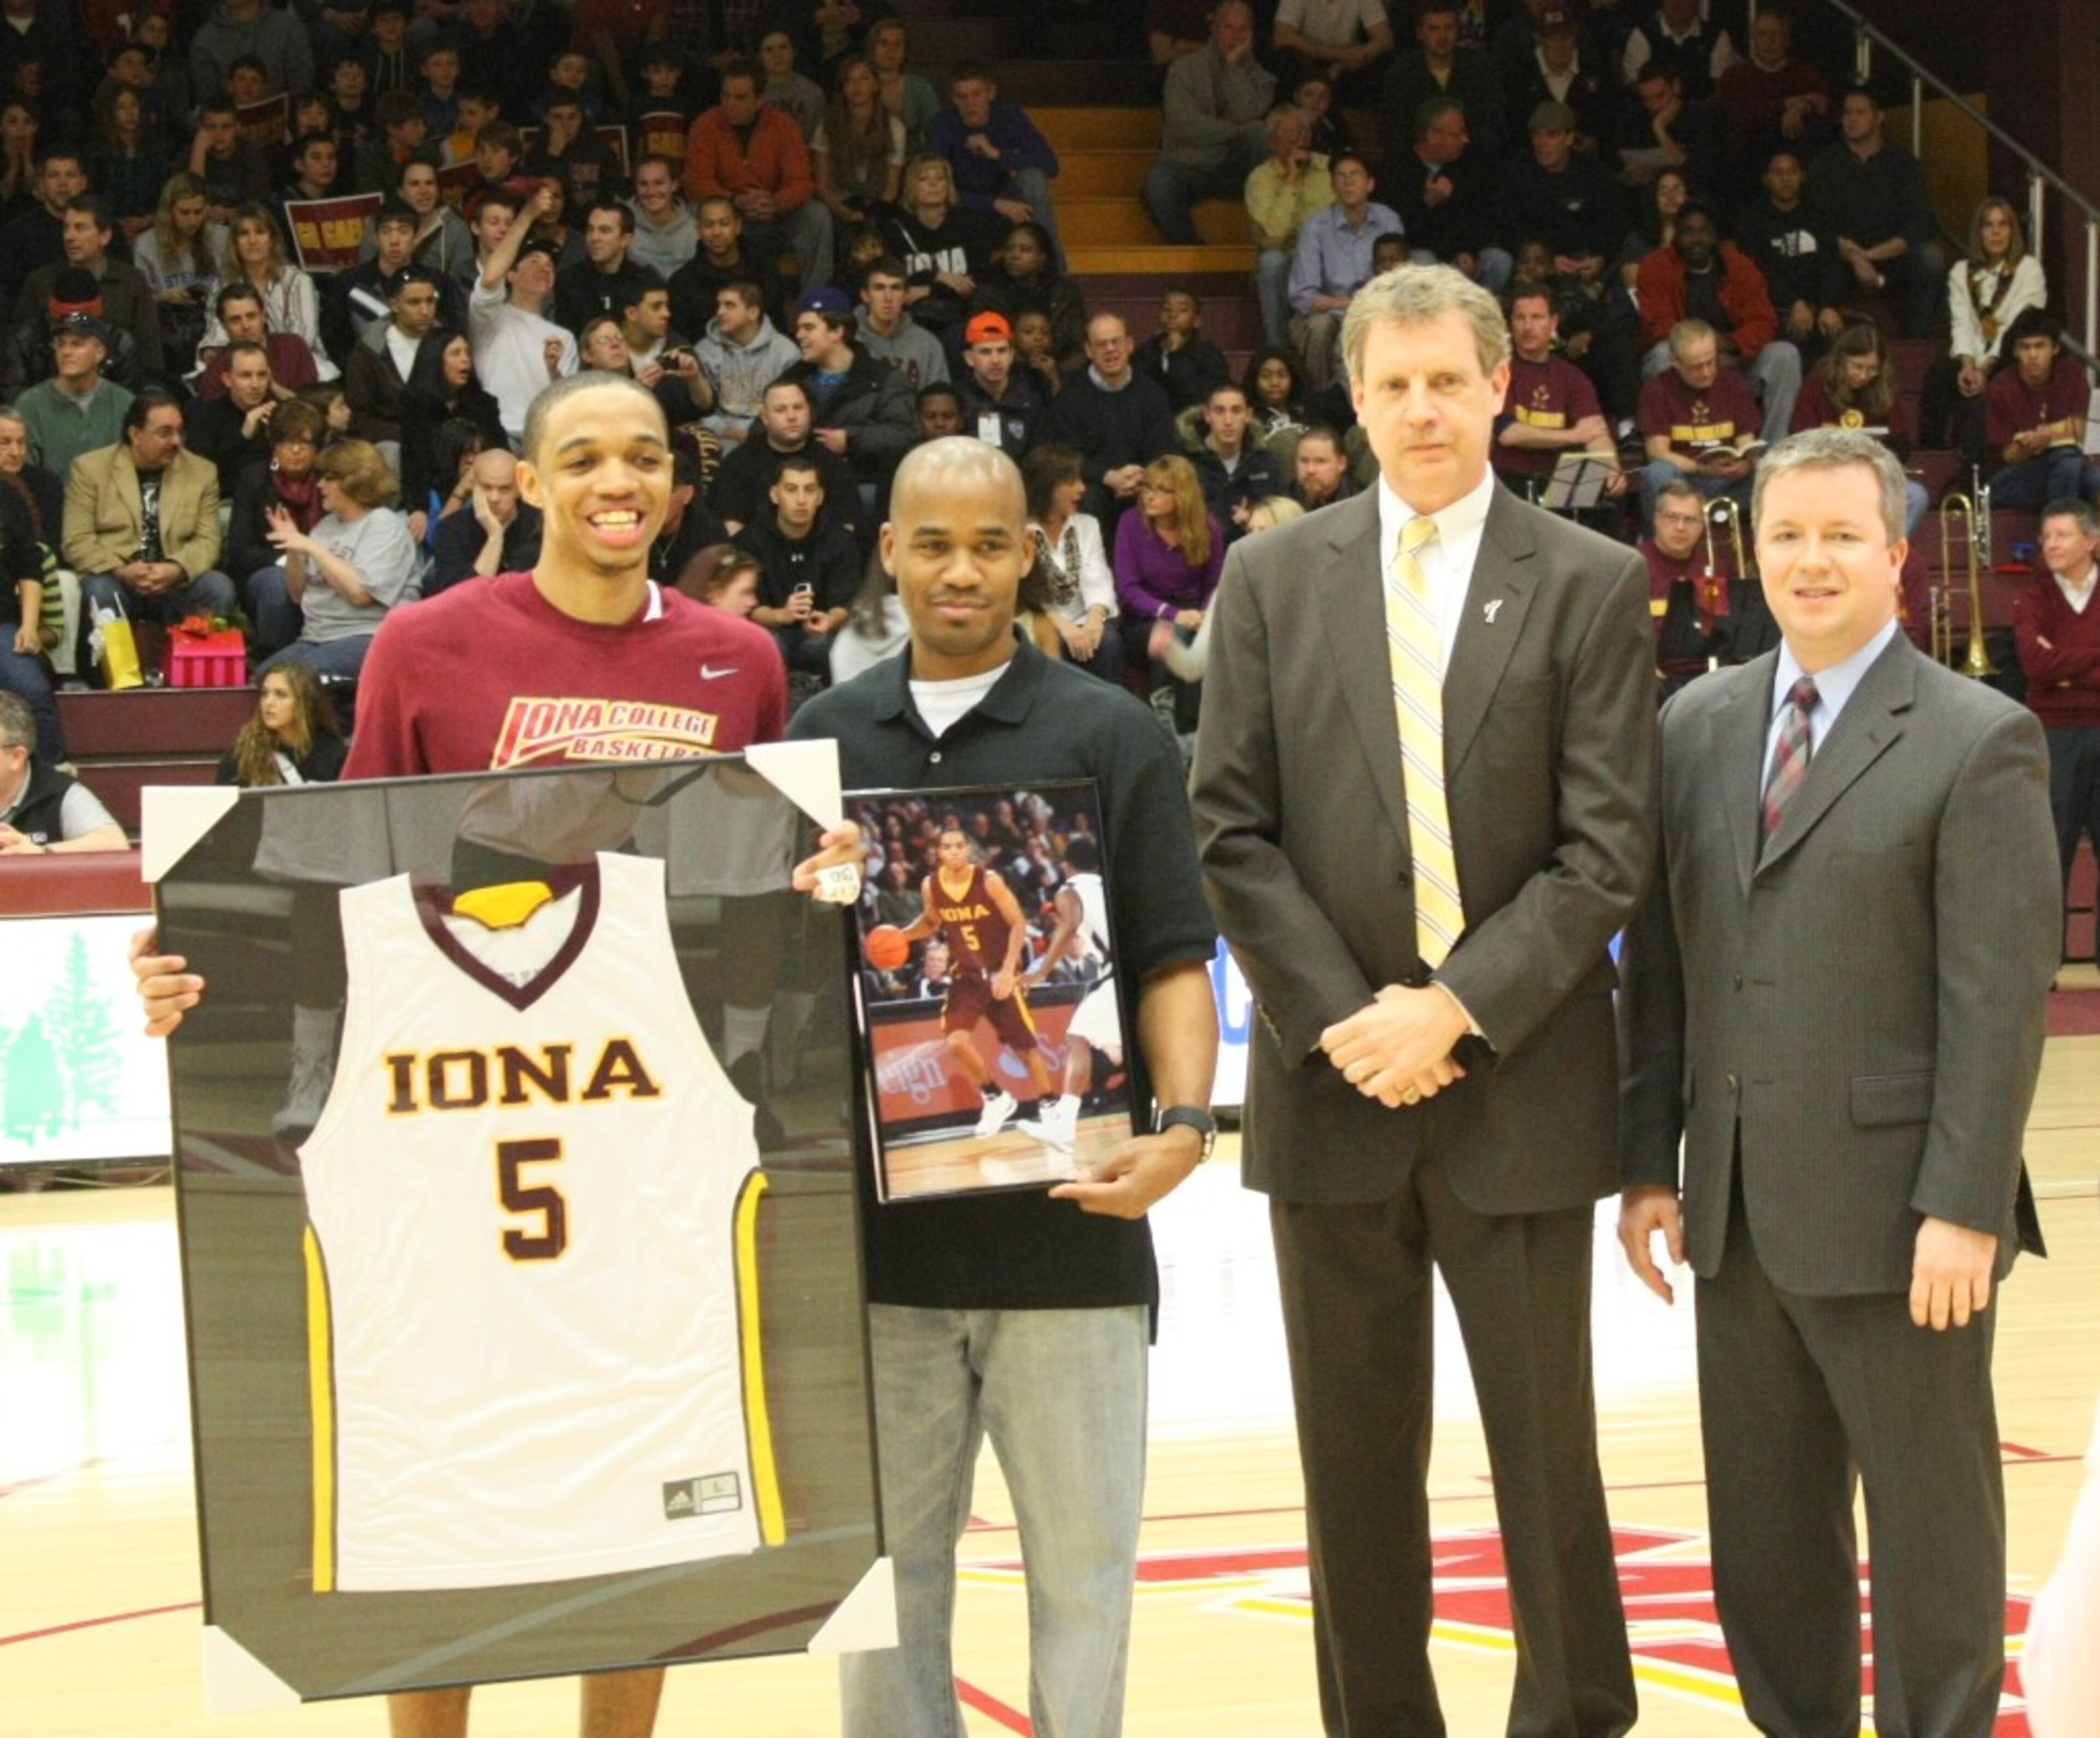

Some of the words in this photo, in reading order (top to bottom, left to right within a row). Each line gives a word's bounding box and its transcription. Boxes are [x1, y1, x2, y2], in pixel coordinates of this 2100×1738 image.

[496, 702, 602, 766] IONA
[608, 705, 711, 737] COLLEGE
[939, 904, 990, 922] IONA
[960, 925, 981, 950] 5
[385, 1036, 663, 1116] IONA
[494, 1136, 569, 1263] 5
